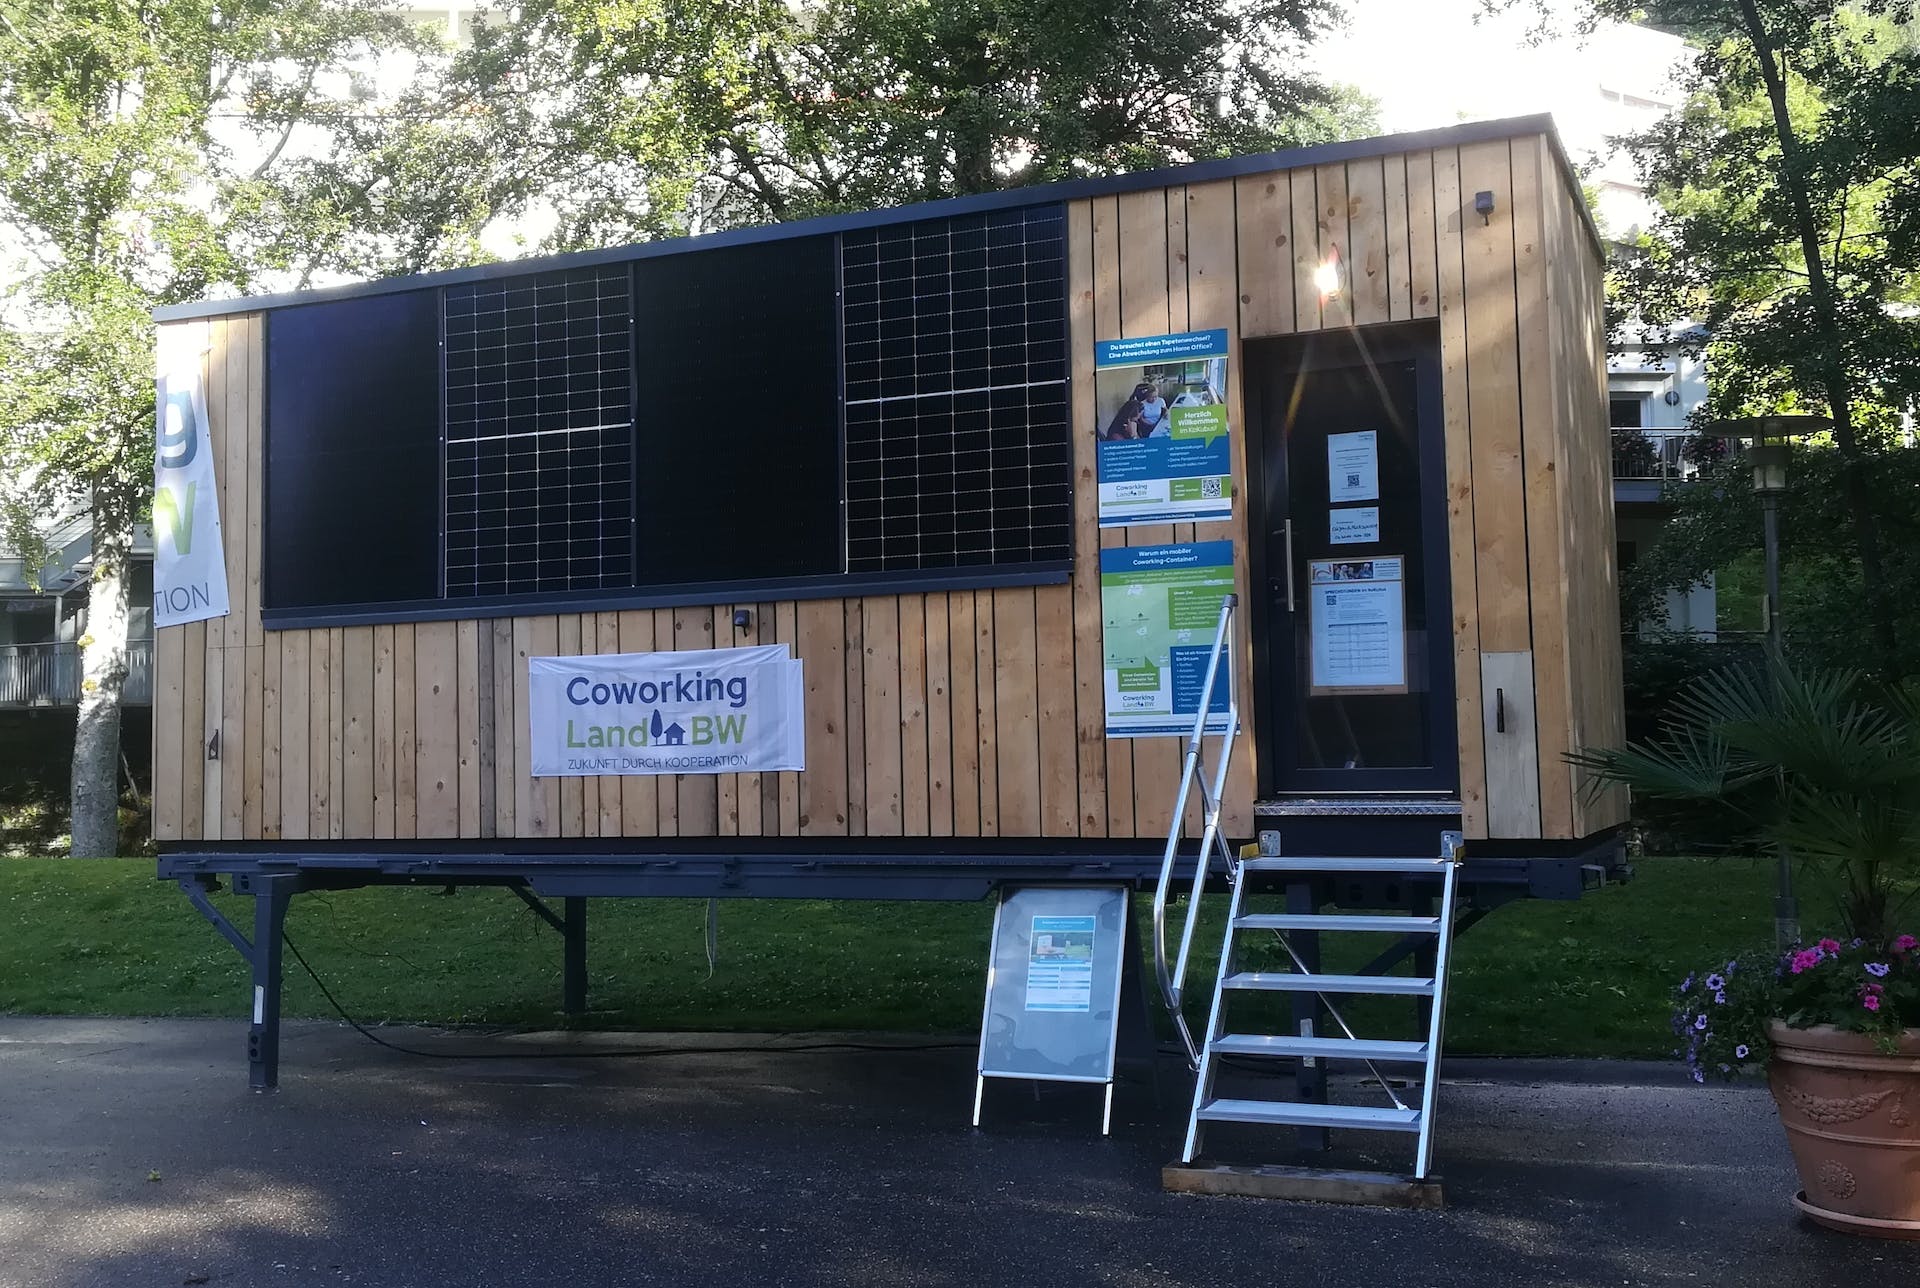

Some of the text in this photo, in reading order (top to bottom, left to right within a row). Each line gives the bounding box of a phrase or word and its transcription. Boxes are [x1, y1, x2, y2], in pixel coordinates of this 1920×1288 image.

[1191, 342, 1213, 351] Office?
[1184, 410, 1212, 418] Herzlich
[1178, 418, 1219, 426] Willkommen
[566, 671, 747, 708] Coworking
[567, 713, 747, 748] Land BW
[568, 754, 748, 770] ZUKUNFT DURCH KOOPERATION
